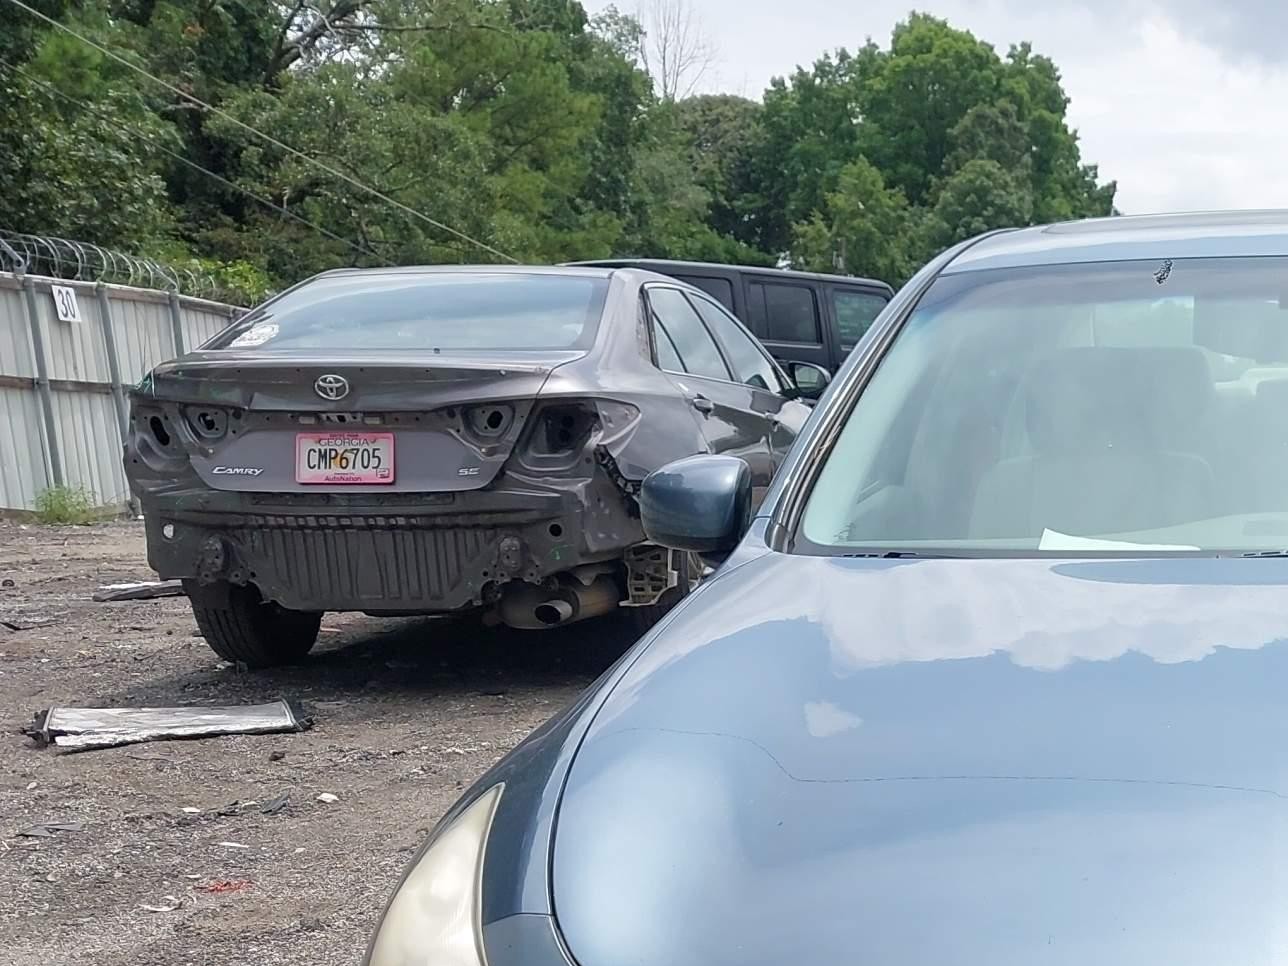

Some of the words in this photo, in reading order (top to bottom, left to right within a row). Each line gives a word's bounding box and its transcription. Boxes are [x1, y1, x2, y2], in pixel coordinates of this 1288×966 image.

[57, 288, 75, 319] 30
[318, 437, 370, 447] GEORGIA
[307, 447, 382, 470] CMP6705
[458, 467, 480, 476] SE
